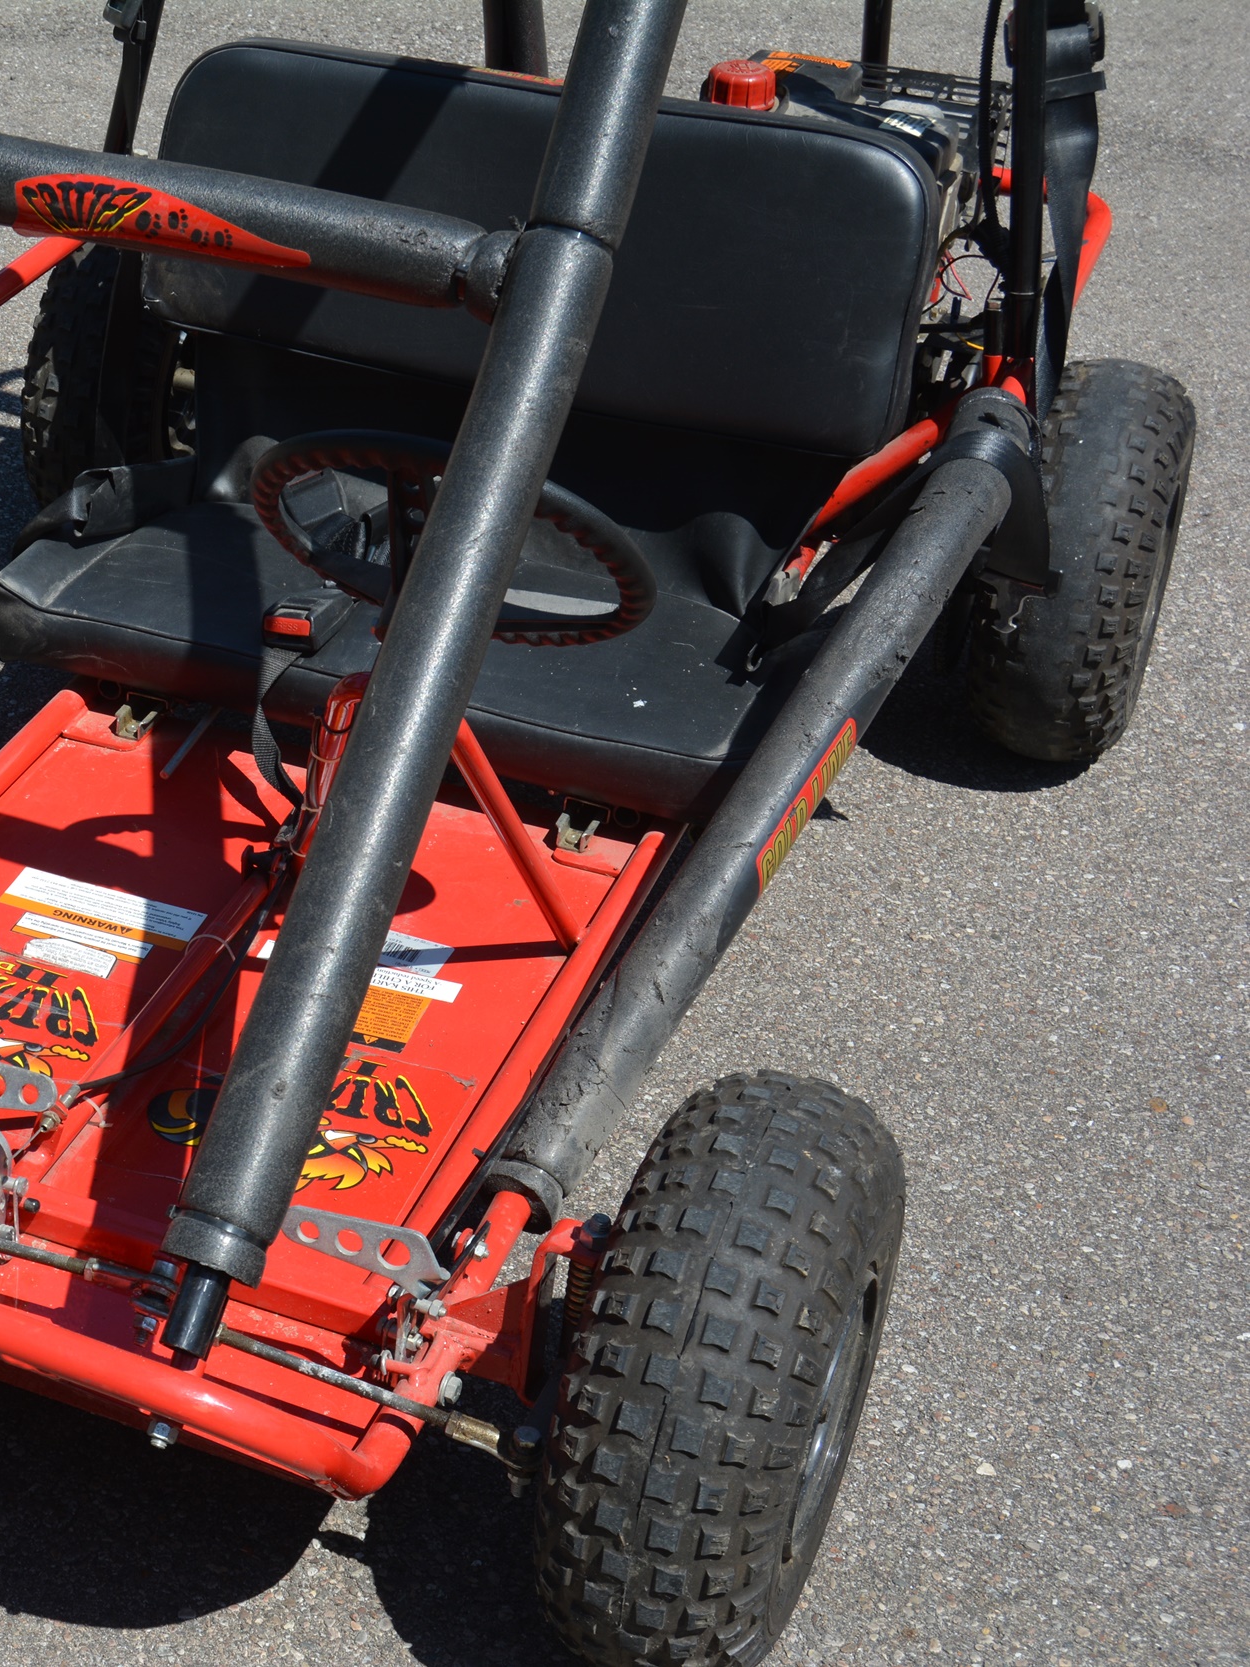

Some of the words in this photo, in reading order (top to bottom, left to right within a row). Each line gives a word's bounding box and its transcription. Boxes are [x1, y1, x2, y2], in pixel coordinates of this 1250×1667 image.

[22, 181, 152, 233] CRITTER
[51, 909, 118, 932] WARNING
[372, 978, 398, 988] KART
[413, 981, 435, 990] FOR
[401, 985, 424, 994] THIS
